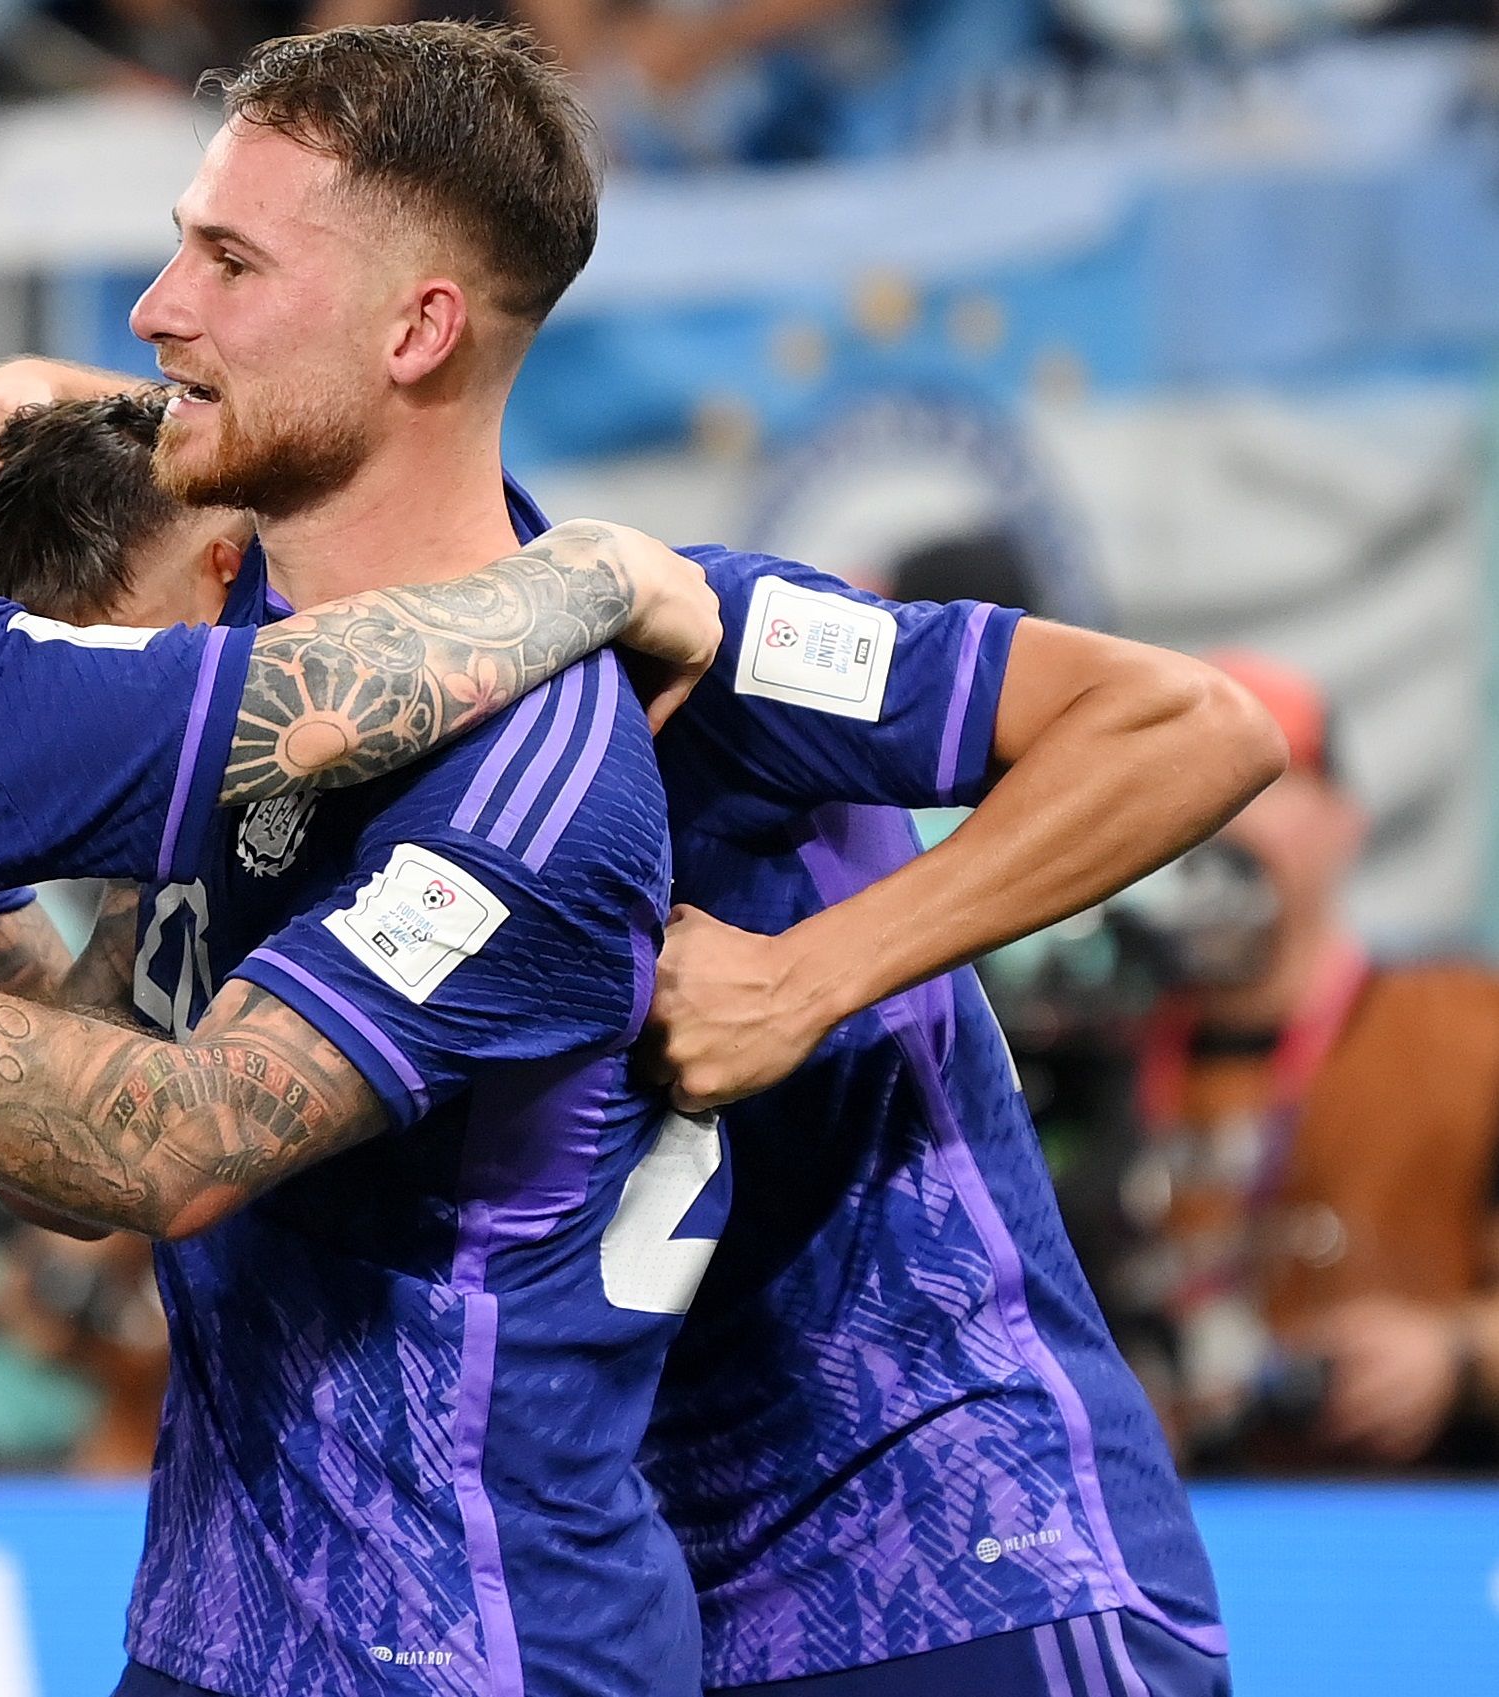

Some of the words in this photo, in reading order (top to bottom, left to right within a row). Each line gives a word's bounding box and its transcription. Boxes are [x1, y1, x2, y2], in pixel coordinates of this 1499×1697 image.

[816, 621, 841, 668] UNITES
[373, 932, 398, 957] FIFA
[285, 1084, 302, 1106] 8
